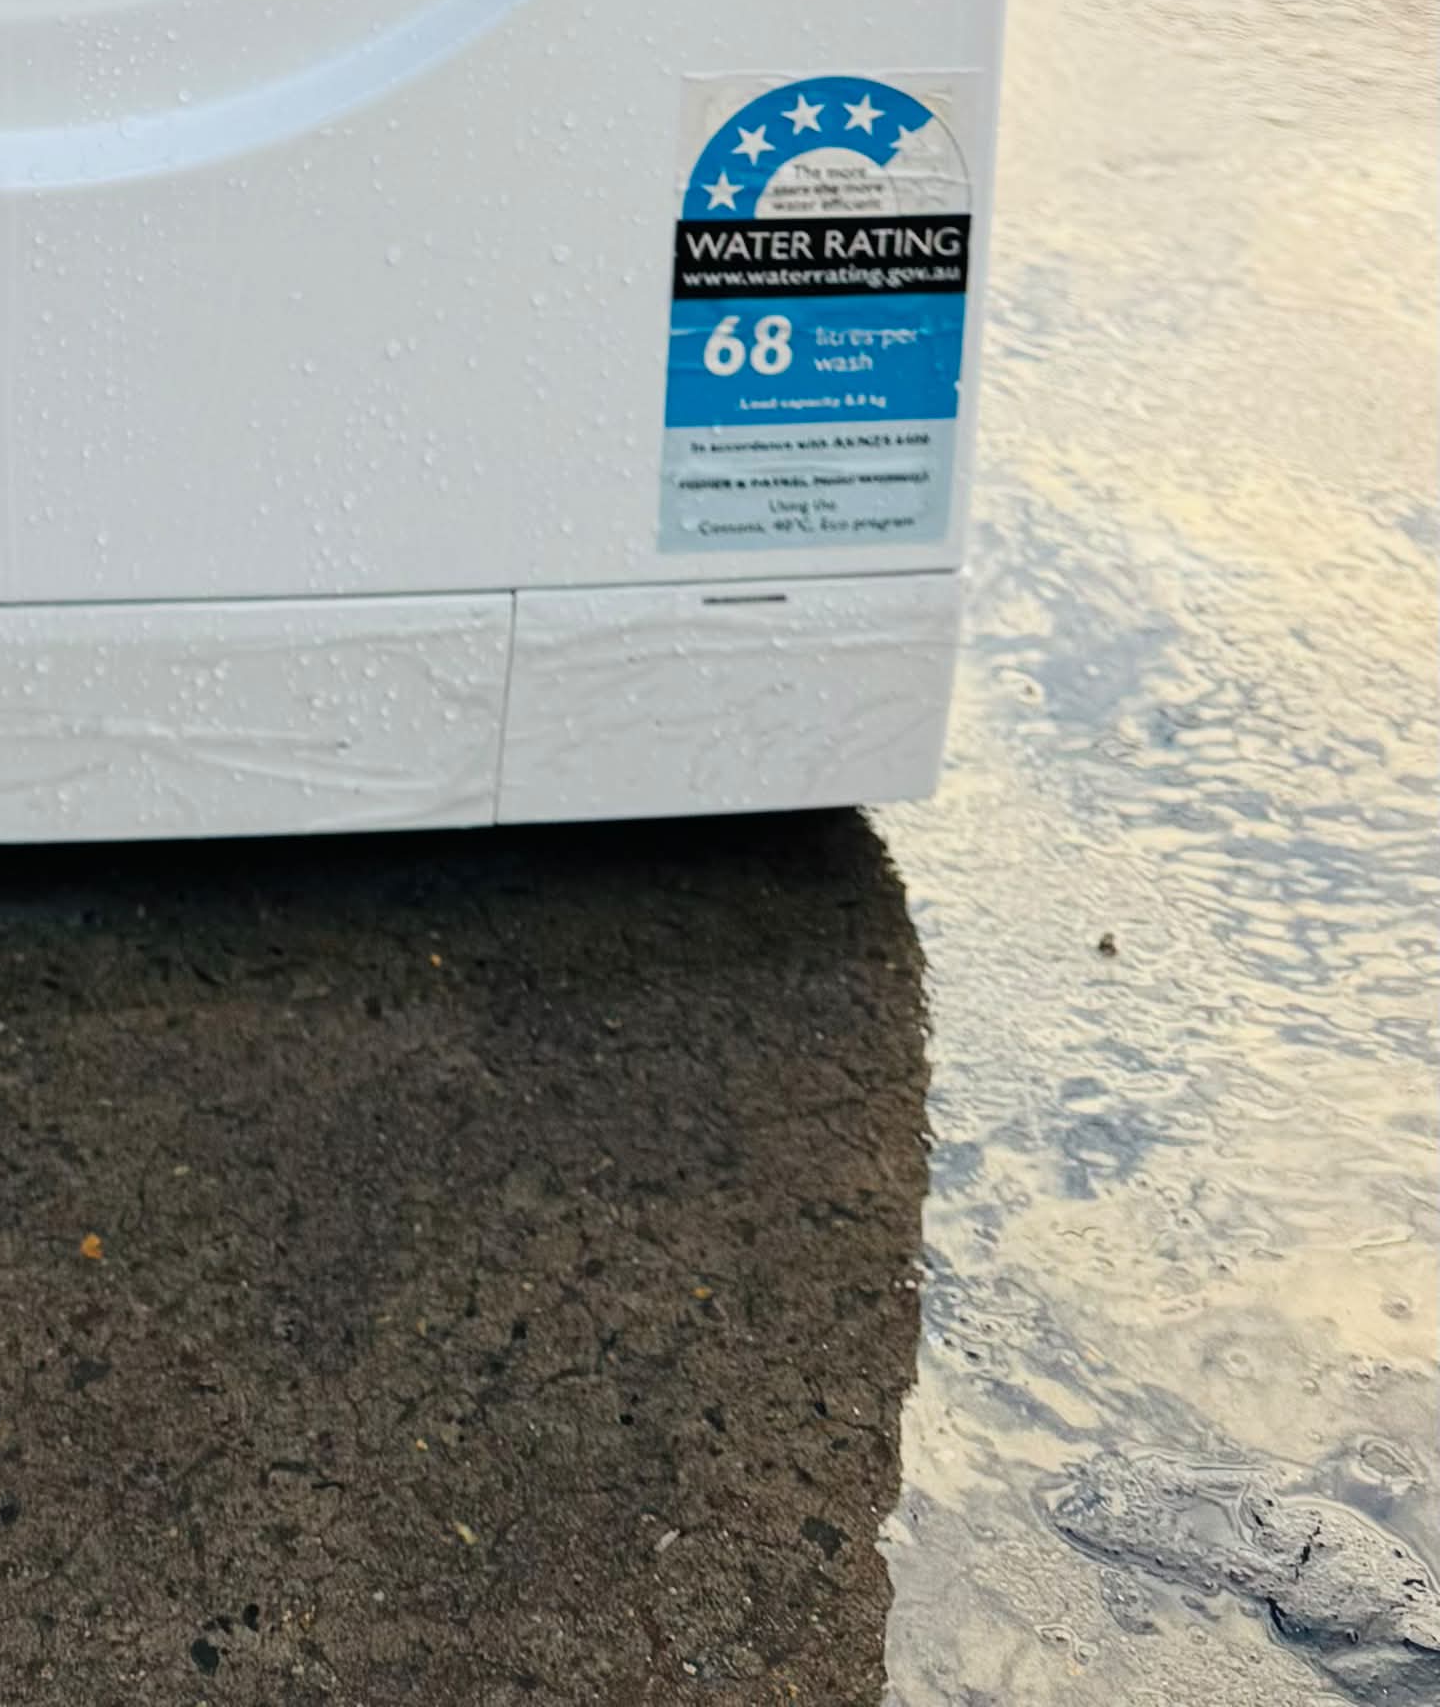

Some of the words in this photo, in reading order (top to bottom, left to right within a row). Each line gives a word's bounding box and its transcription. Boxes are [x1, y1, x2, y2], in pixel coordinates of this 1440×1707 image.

[685, 230, 814, 261] WATER
[824, 227, 961, 259] RATING
[682, 263, 961, 289] www.waterrating.gov.au
[703, 315, 793, 376] 68
[881, 328, 918, 350] per
[814, 352, 873, 372] wash
